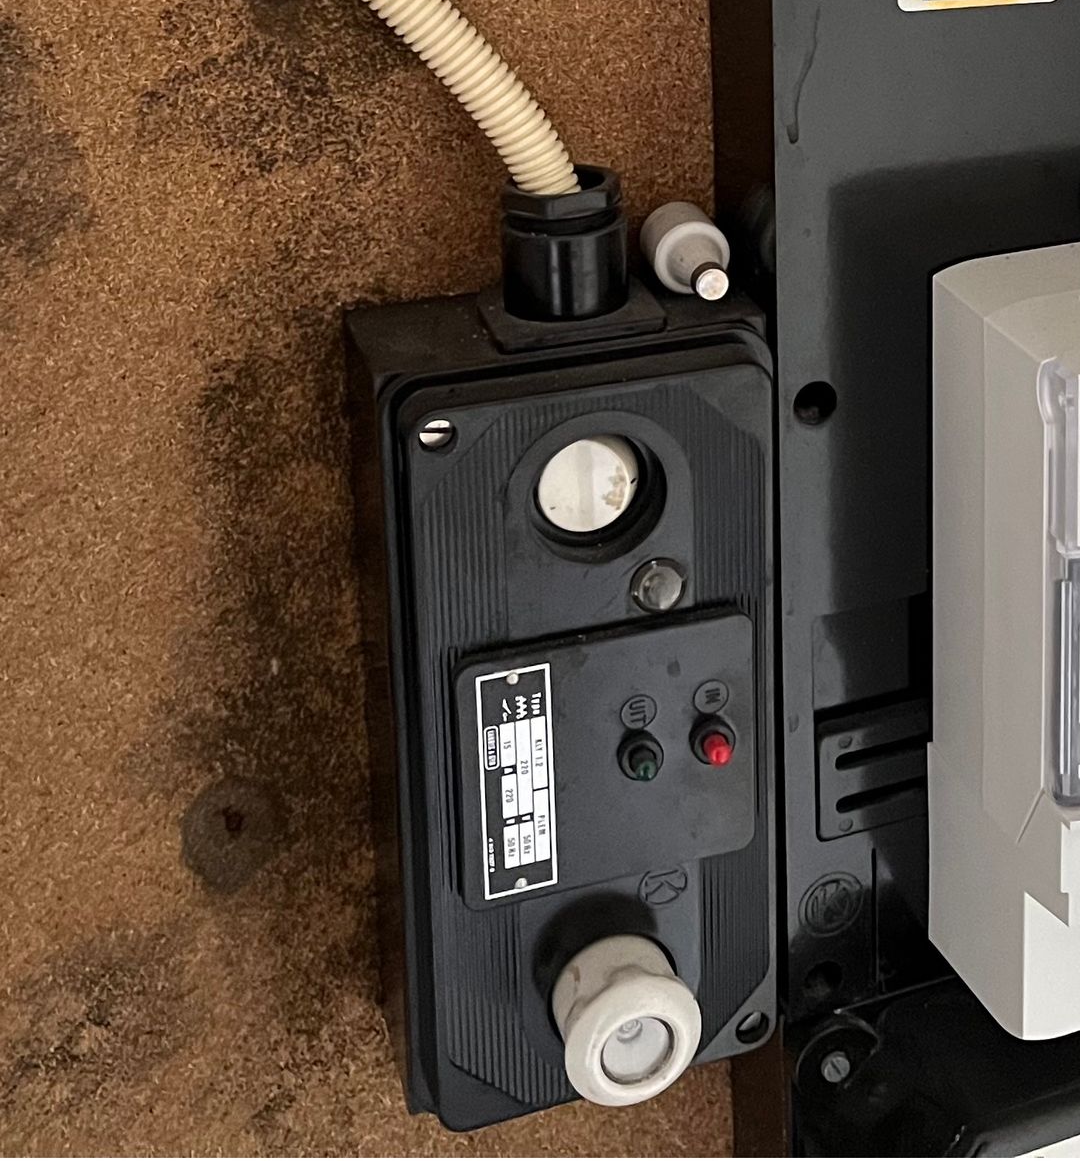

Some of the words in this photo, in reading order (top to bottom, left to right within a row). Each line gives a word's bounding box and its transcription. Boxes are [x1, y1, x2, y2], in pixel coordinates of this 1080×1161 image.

[629, 699, 647, 724] UIT
[520, 760, 529, 775] 220
[505, 788, 514, 803] 220
